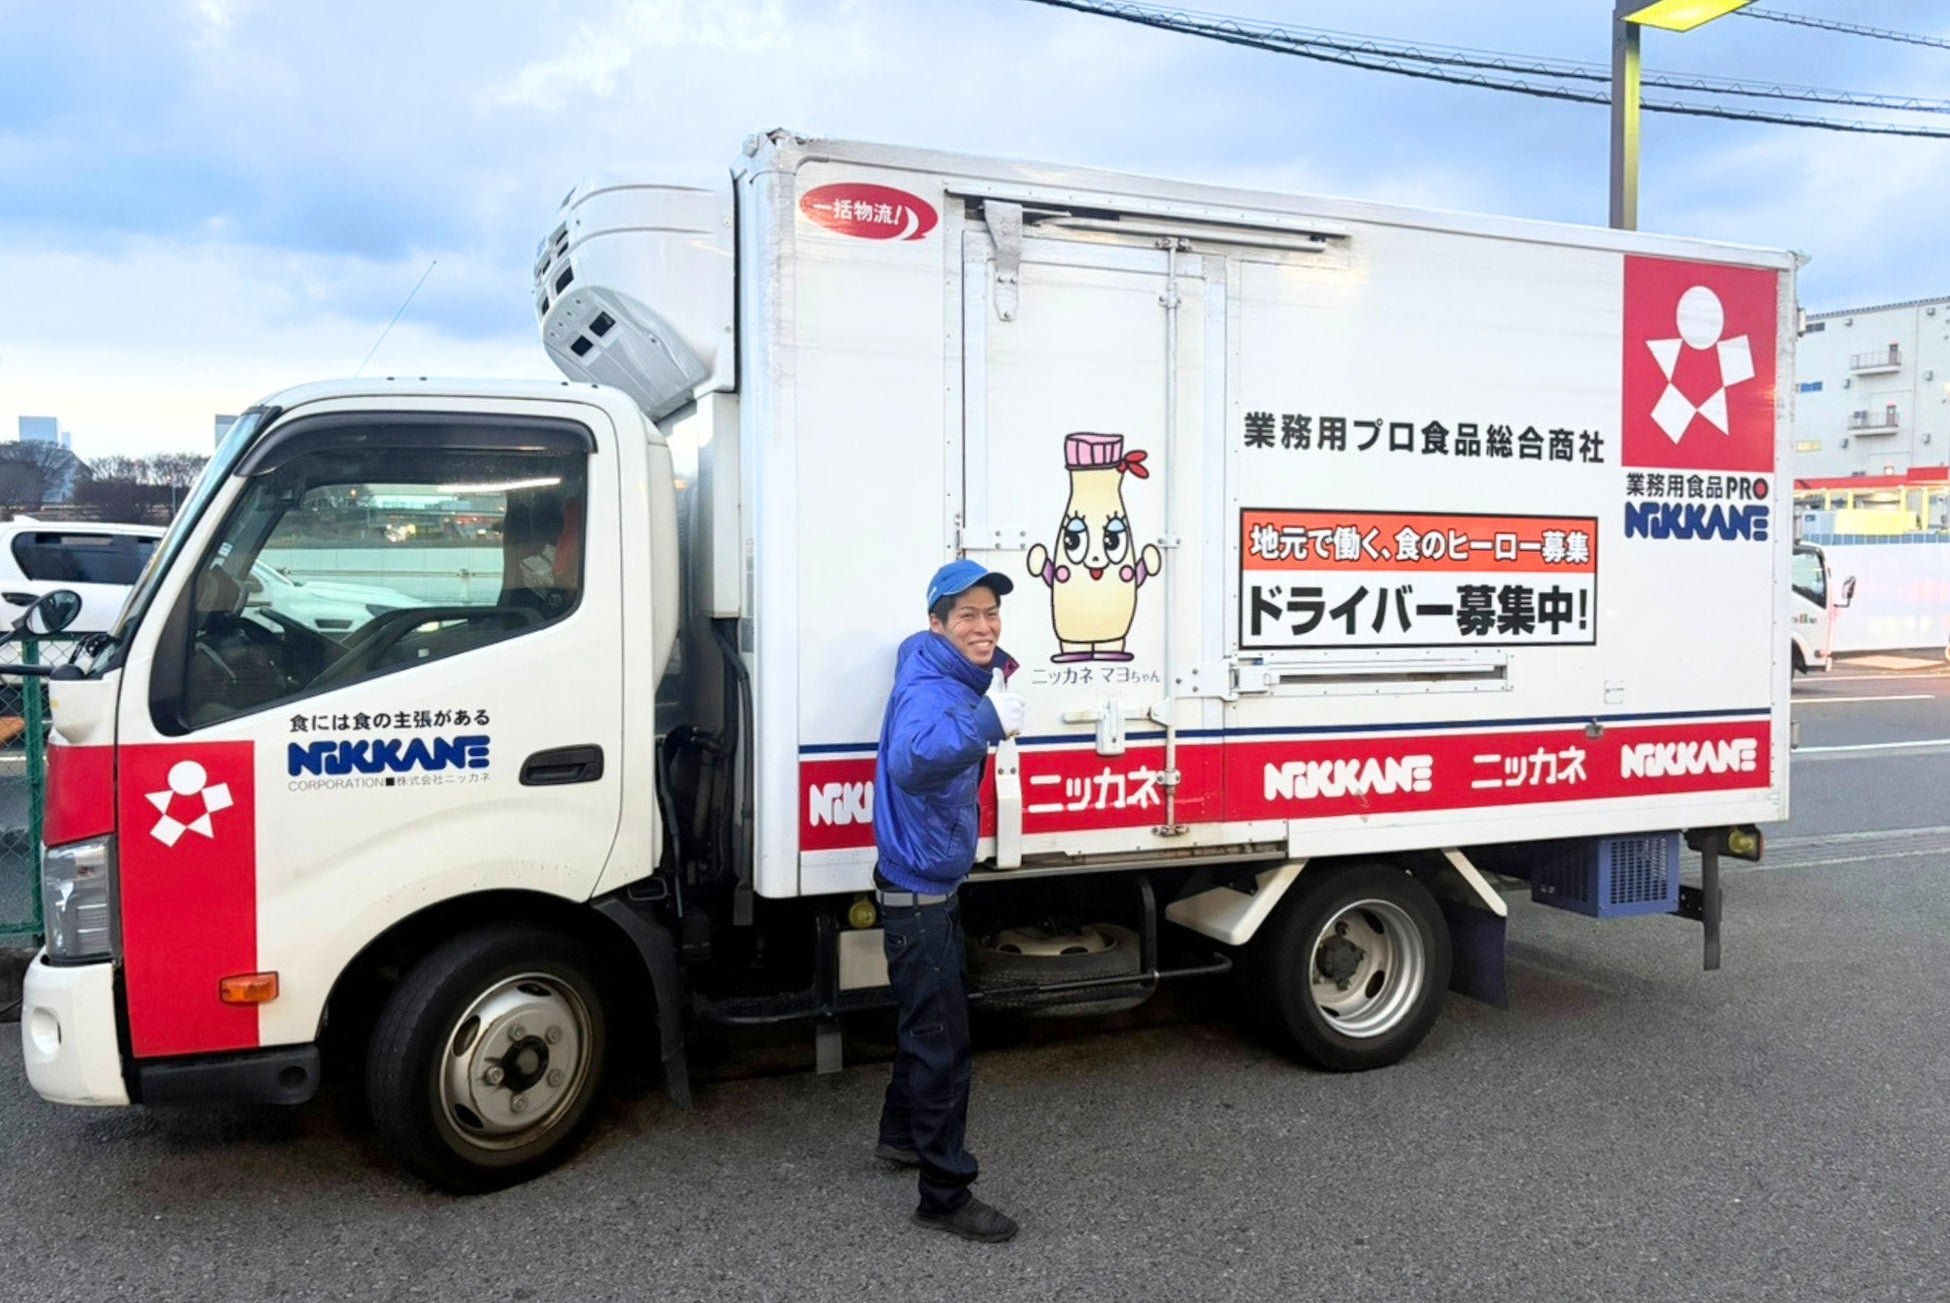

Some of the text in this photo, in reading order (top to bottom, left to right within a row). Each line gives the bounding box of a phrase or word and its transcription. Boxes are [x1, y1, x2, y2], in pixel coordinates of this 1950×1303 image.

[813, 199, 902, 225] 一括物流!
[1244, 412, 1604, 463] 業務用プロ食品総合商社
[1625, 501, 1770, 541] NIKKANE
[1250, 524, 1589, 564] 地元で働く、食のヒーロー募集
[1250, 584, 1588, 636] ドライバー募集中!
[1032, 667, 1160, 685] ニッカネ マヨちゃん
[290, 709, 490, 732] 食には食の主張がある
[288, 735, 490, 776] NIKKANE
[1028, 765, 1161, 813] ニッカネ
[1263, 755, 1433, 800] NIKKANE
[1471, 745, 1587, 789] ニッカネ
[1620, 738, 1757, 778] NIKKANE
